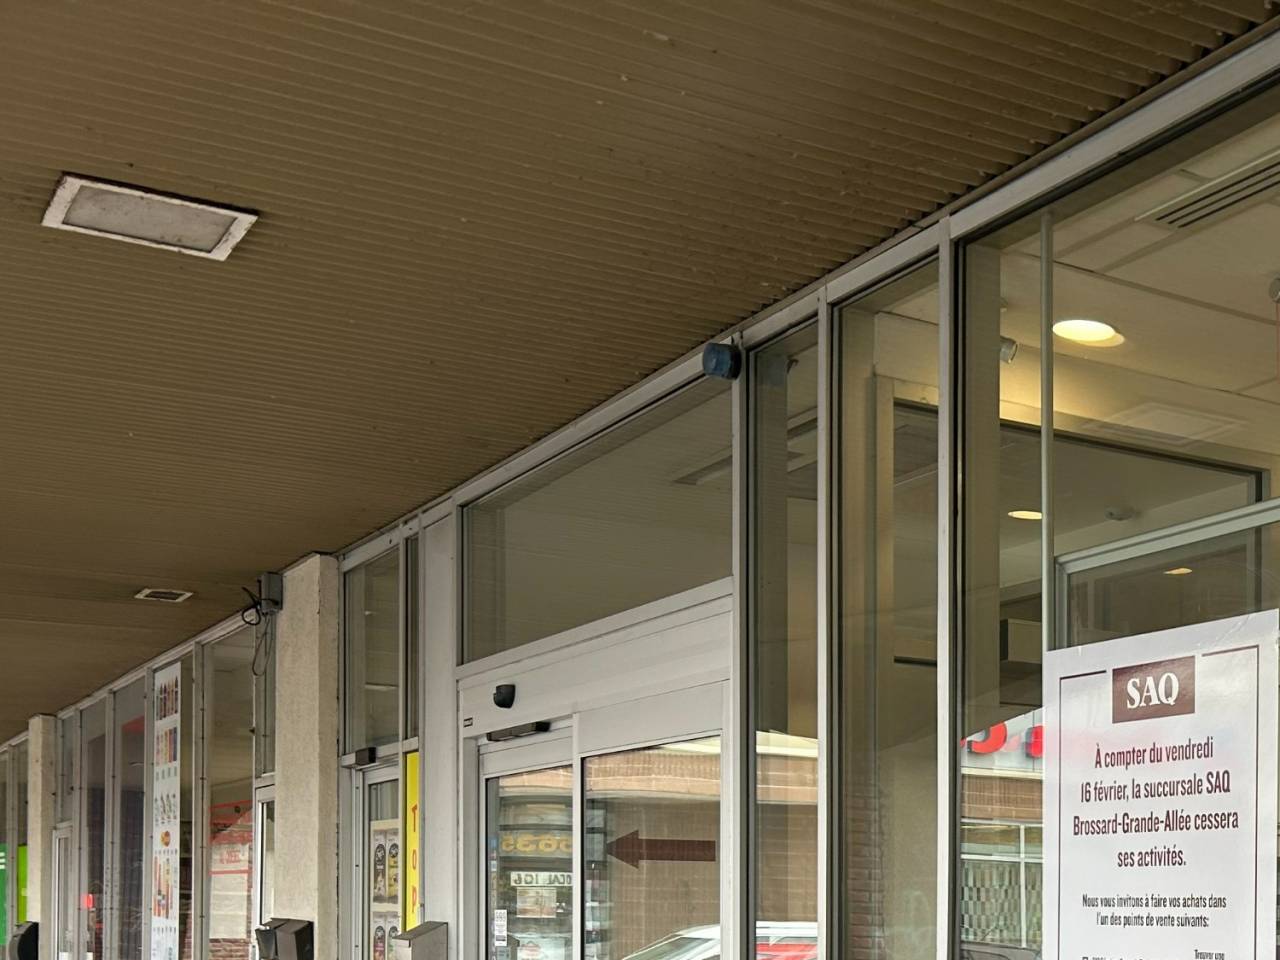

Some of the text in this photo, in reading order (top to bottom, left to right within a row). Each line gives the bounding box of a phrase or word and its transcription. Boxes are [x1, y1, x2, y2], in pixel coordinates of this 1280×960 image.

[1126, 672, 1179, 709] SAQ
[1094, 735, 1213, 771] À compter du vendredi
[1080, 769, 1231, 803] 16 février, la succursale SAQ
[1073, 808, 1239, 836] Brossard-Grande-Allée cessera
[1117, 843, 1186, 868] ses activités.
[1082, 893, 1227, 908] Nous vous invitons à faire vos achats dans
[1109, 911, 1122, 926] des
[1122, 912, 1144, 928] points
[1145, 912, 1154, 927] de
[1154, 914, 1175, 927] vente
[1176, 912, 1209, 928] suivants:
